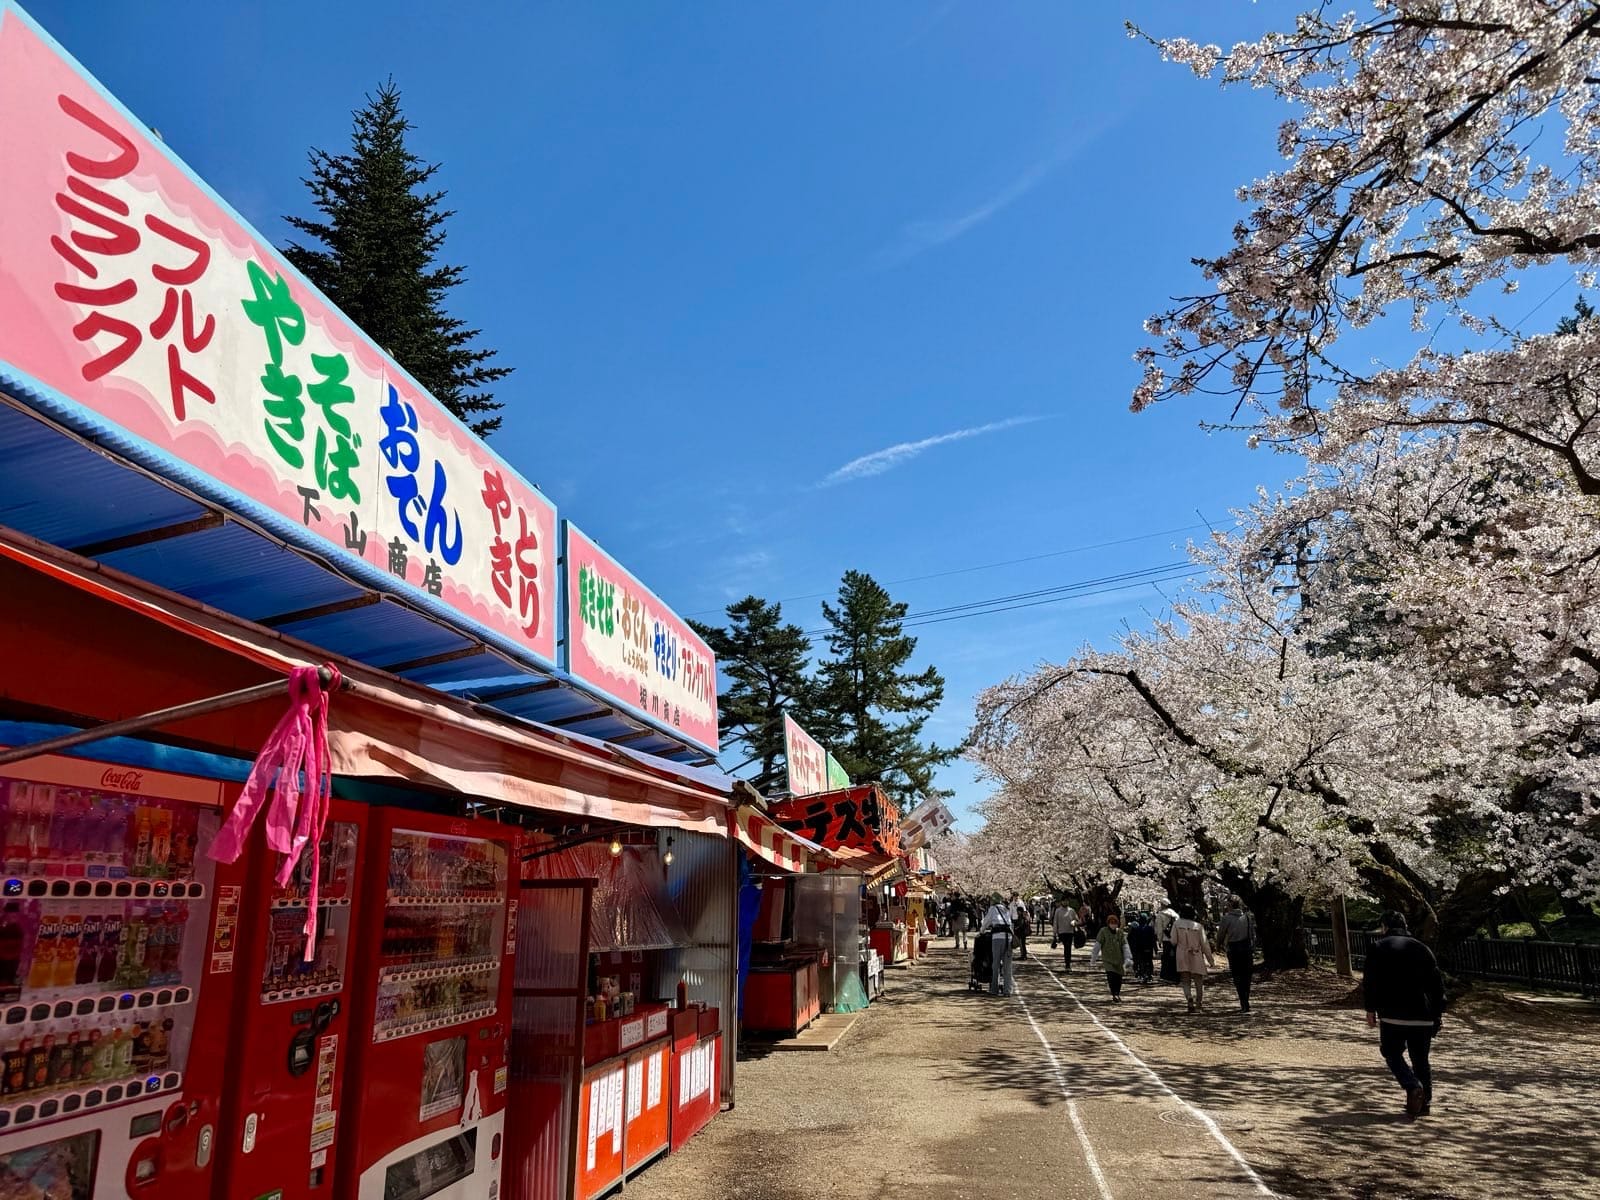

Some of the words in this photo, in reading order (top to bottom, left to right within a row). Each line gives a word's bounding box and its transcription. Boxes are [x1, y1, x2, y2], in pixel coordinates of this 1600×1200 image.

[51, 94, 142, 381] フランク
[145, 214, 215, 421] フルト
[241, 260, 306, 469] やき
[307, 353, 362, 504] そば
[296, 484, 443, 598] 下山商店
[379, 383, 462, 566] おでん
[481, 470, 512, 608] やき
[515, 507, 539, 638] とり
